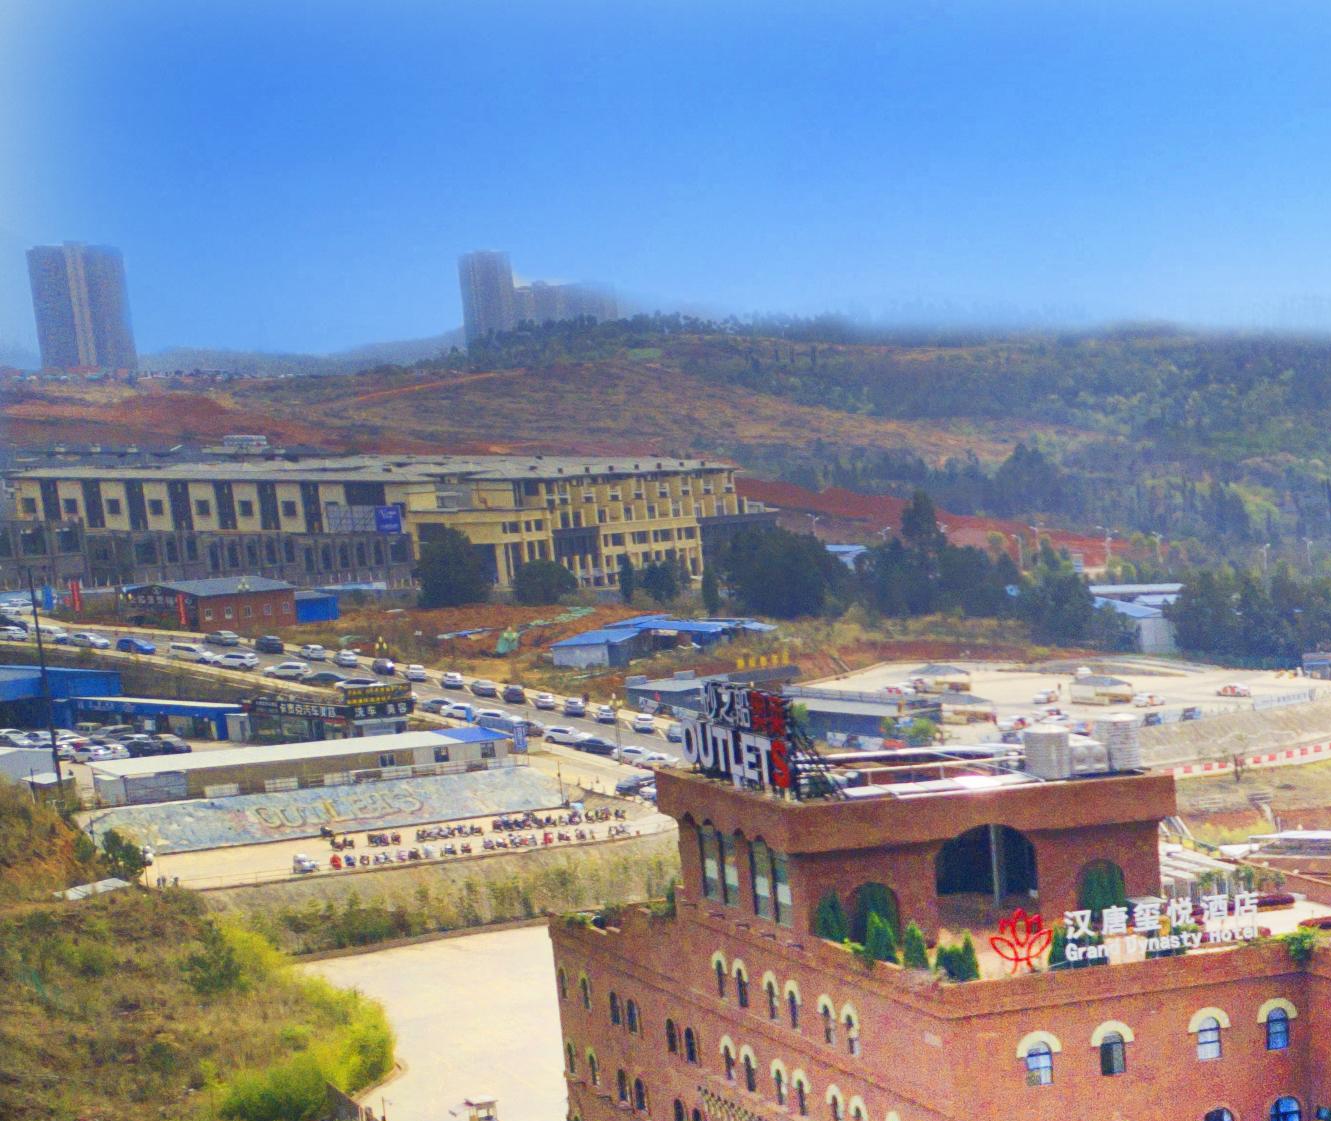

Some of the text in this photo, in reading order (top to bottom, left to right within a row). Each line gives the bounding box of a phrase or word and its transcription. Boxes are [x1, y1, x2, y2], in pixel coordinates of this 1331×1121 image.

[681, 718, 790, 789] OUTLETS
[1063, 892, 1260, 940] 汉唐玺悦酒店
[1064, 926, 1259, 962] Grand Dynasty Hotel
